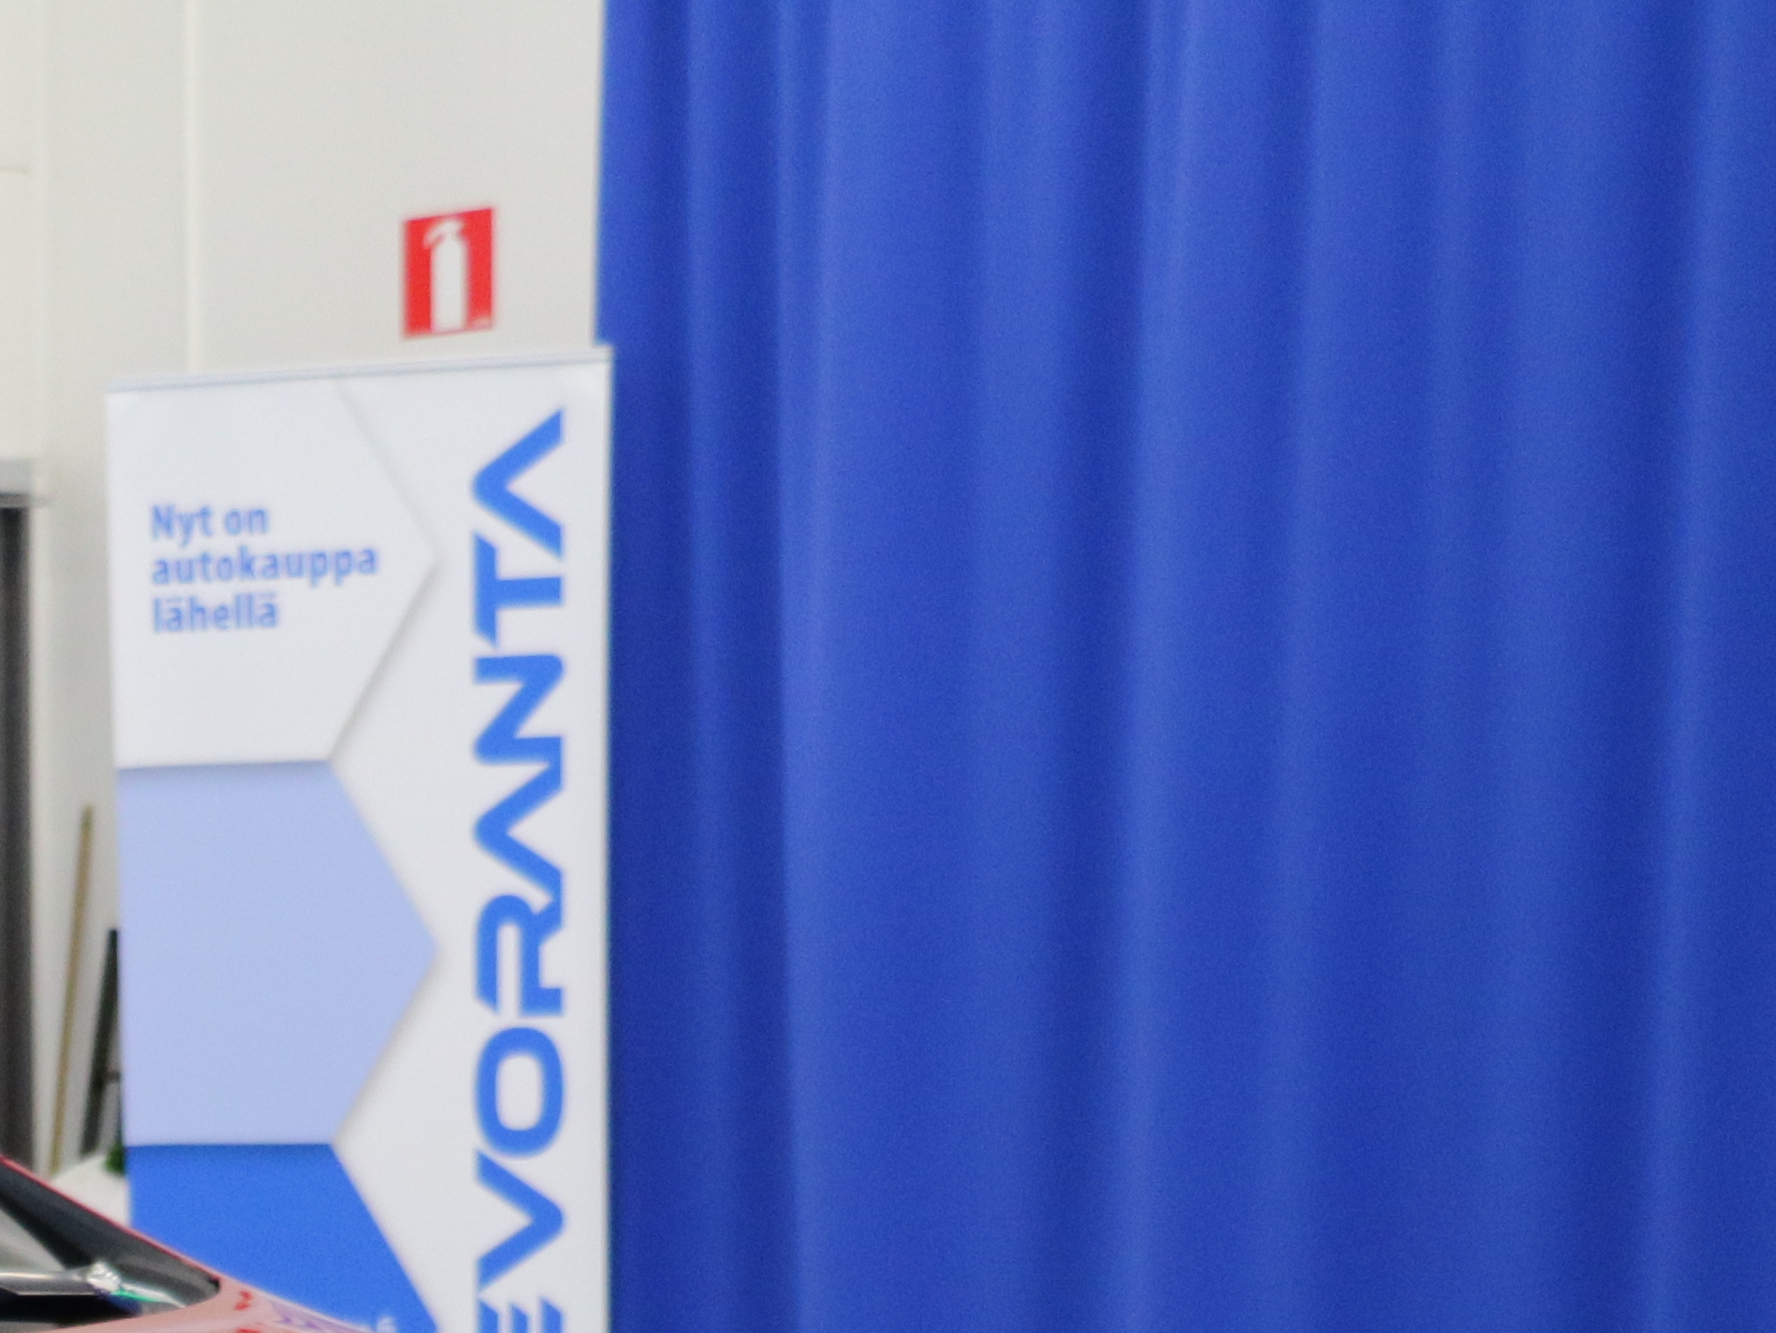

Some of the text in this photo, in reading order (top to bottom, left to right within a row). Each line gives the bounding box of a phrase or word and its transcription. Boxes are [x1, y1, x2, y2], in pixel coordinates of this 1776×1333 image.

[152, 505, 268, 547] Nyt on
[151, 545, 378, 587] autokauppa
[152, 592, 279, 633] lähellä
